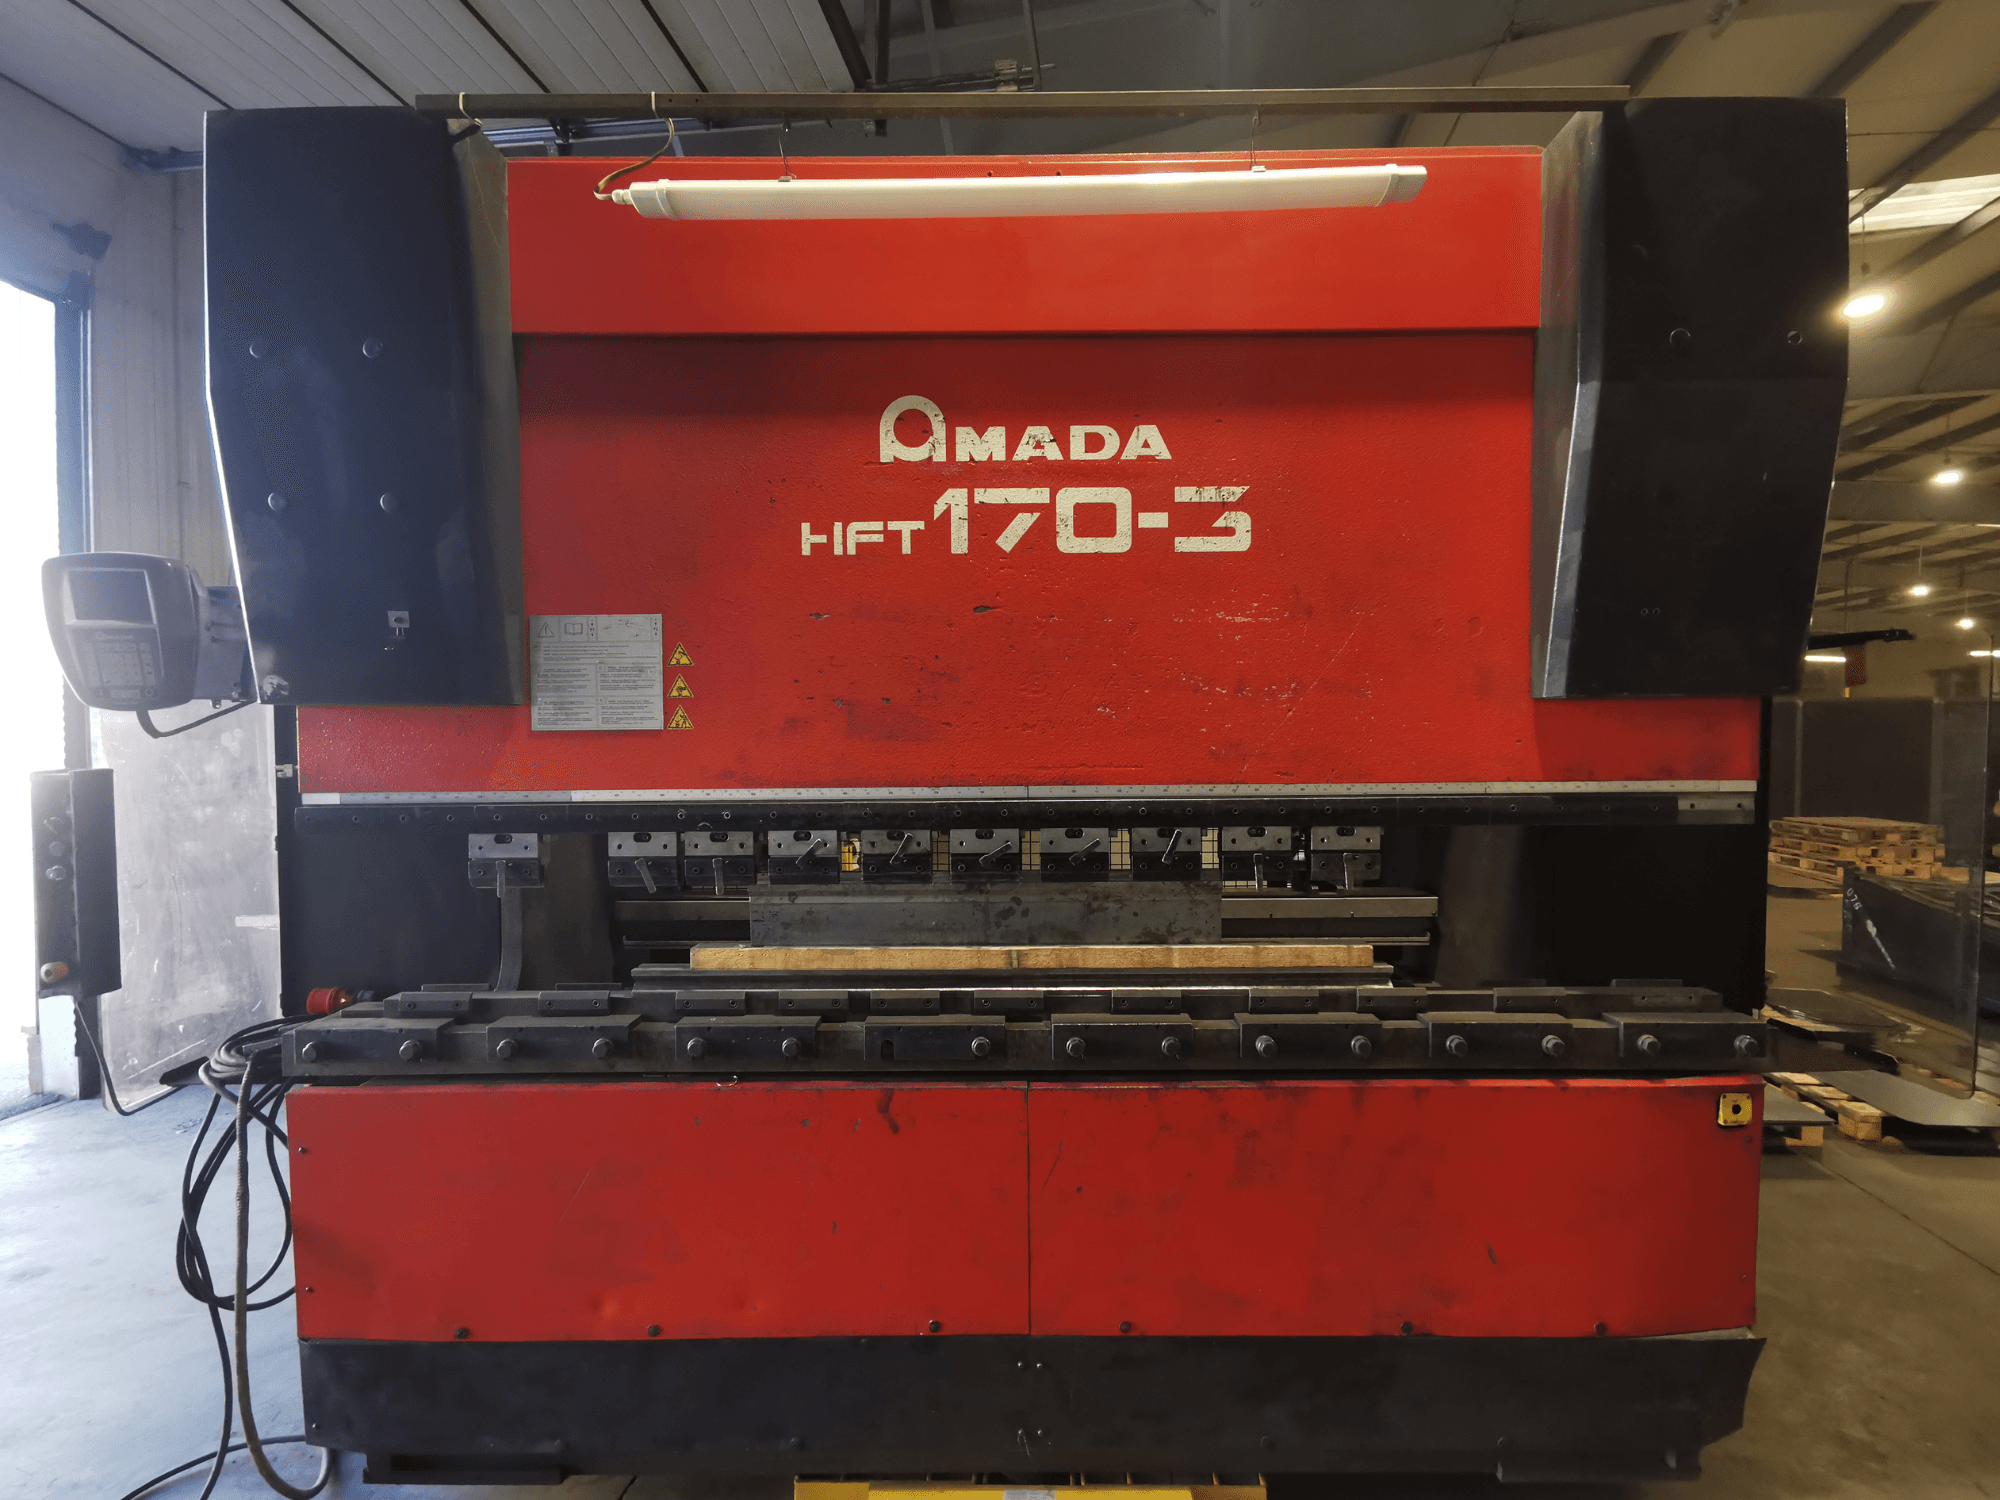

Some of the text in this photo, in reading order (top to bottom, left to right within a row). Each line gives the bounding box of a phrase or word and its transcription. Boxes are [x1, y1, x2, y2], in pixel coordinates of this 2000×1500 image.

[880, 395, 1172, 463] AMADA
[801, 486, 1252, 555] HFT 170-3
